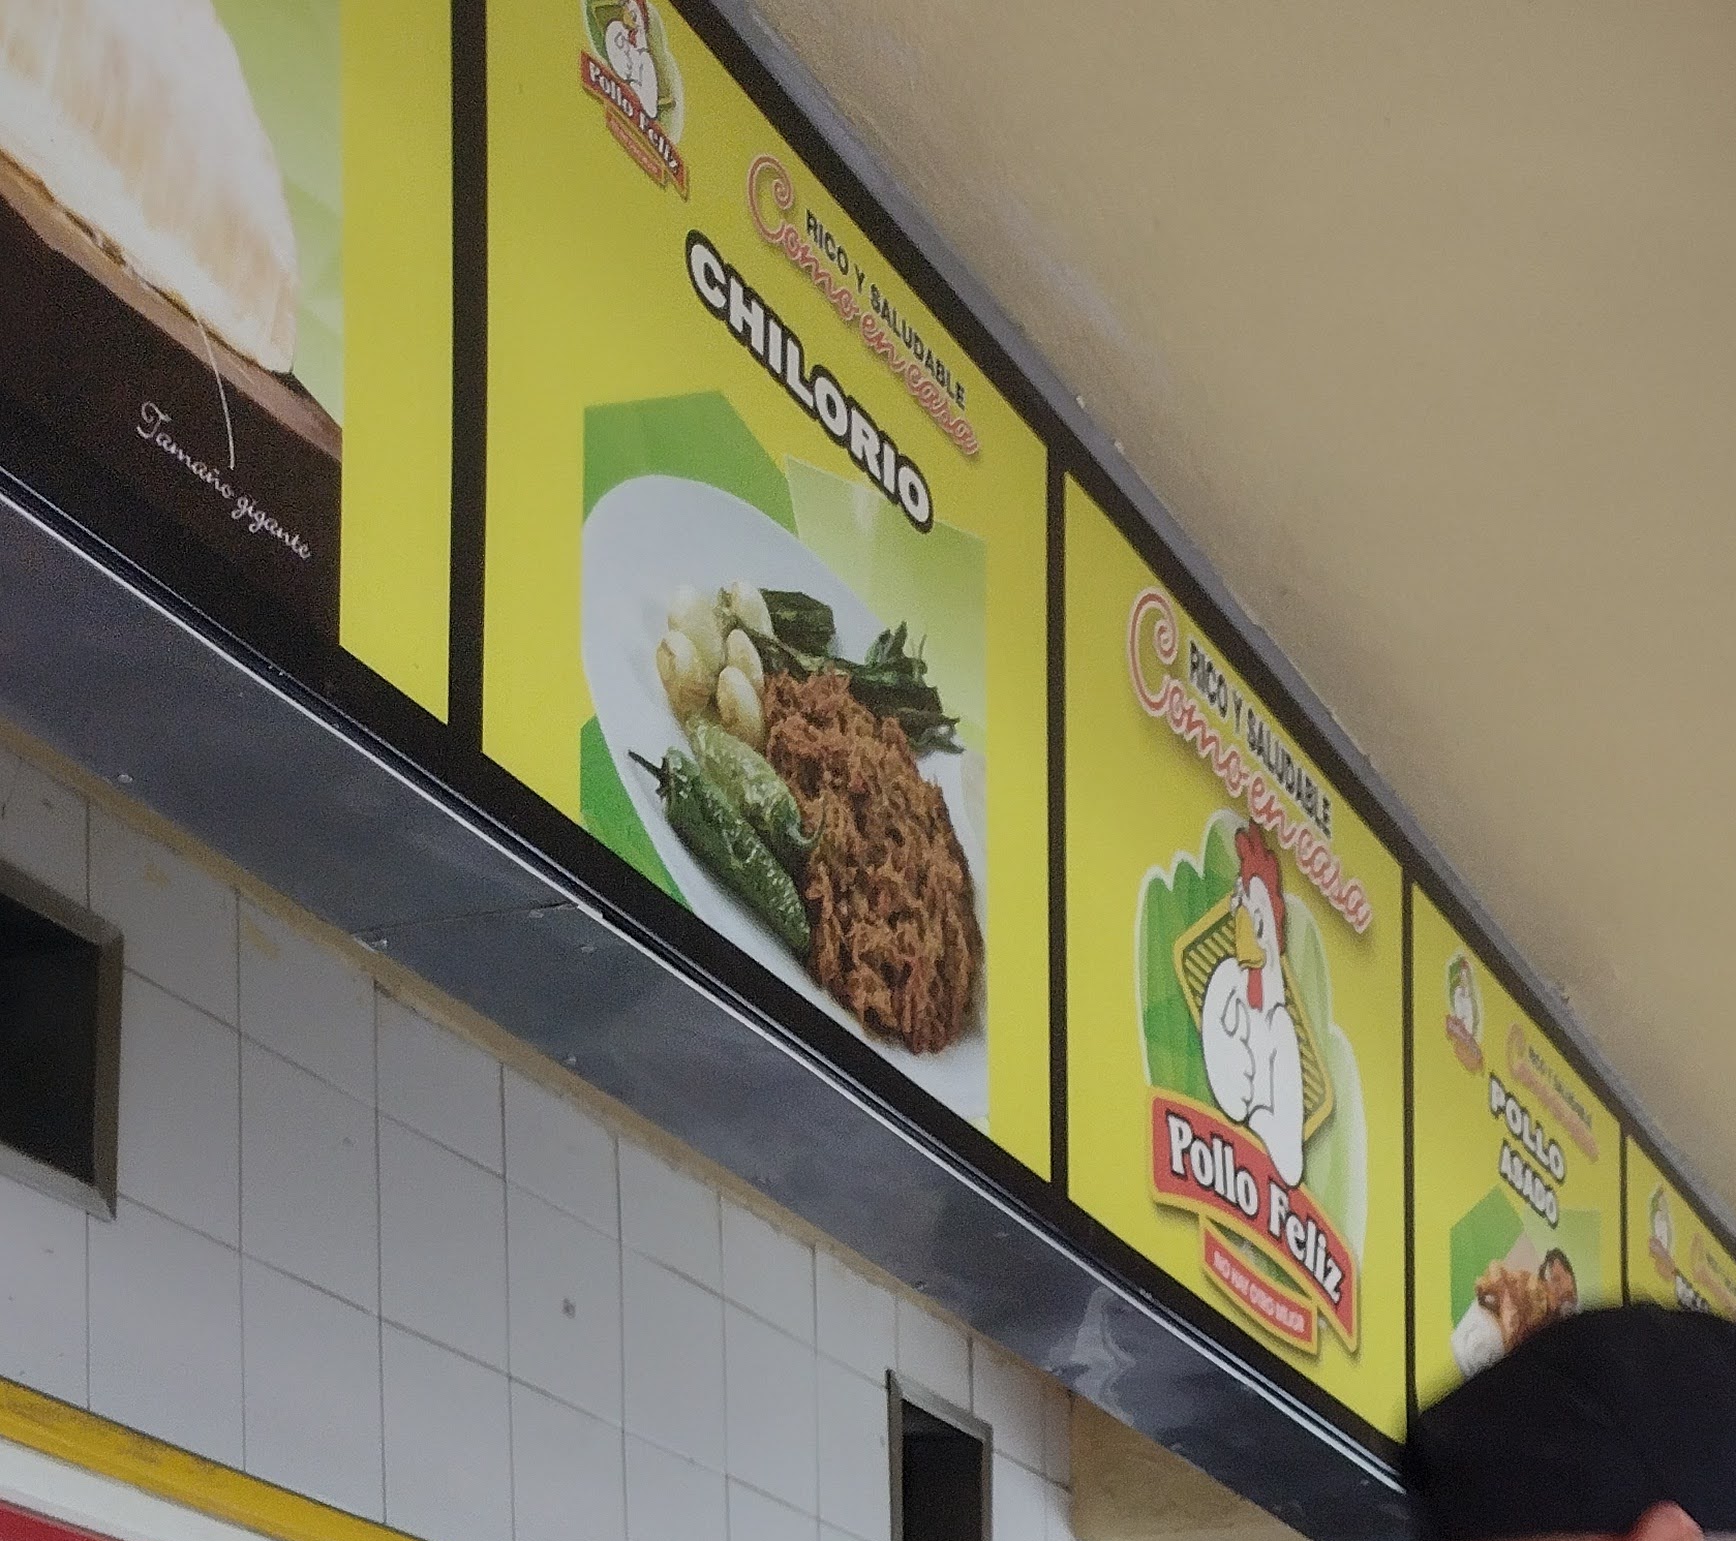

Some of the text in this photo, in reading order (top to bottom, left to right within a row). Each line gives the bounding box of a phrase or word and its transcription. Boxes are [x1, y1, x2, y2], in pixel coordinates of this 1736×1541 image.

[686, 231, 933, 533] CHILORIO
[804, 208, 967, 411] RICO Y SALUDABLE
[136, 400, 312, 560] Tamaño gigante
[1188, 640, 1229, 719] RICO
[1246, 706, 1332, 840] SALUDABLE
[1165, 1109, 1260, 1219] Pollo
[1266, 1178, 1345, 1306] Feliz
[1489, 1070, 1566, 1186] POLLO
